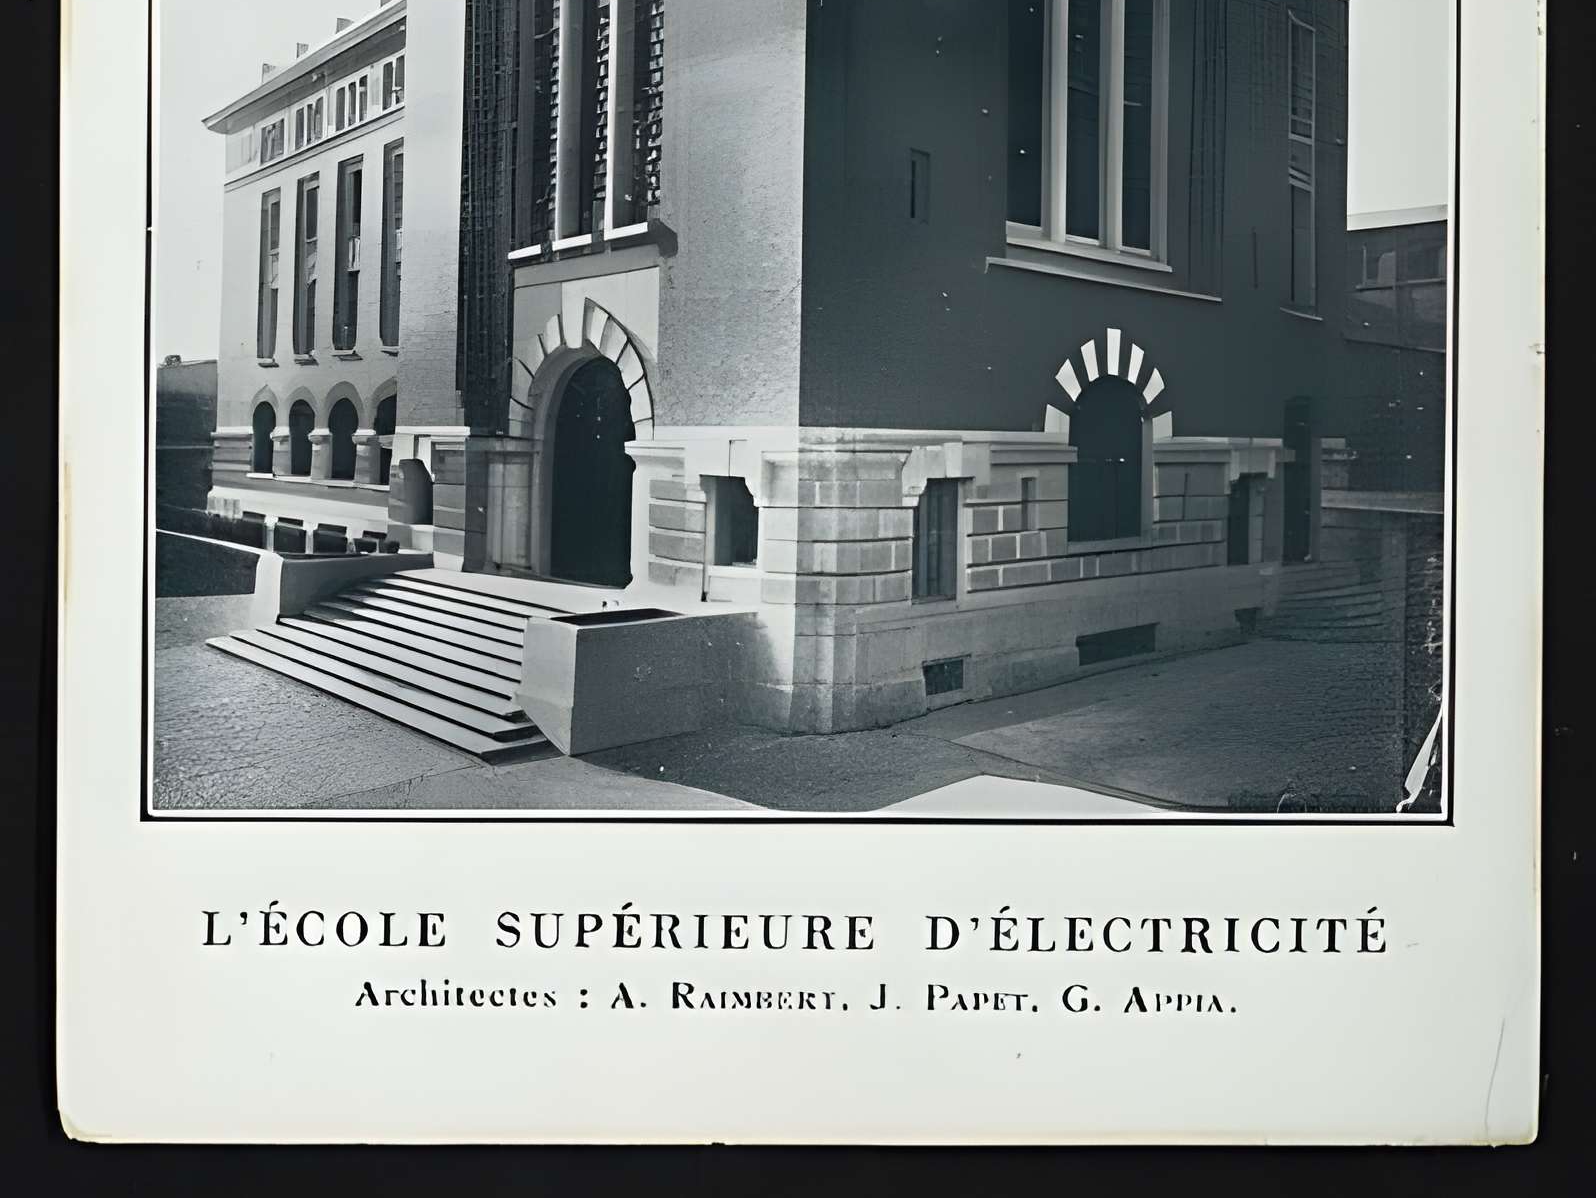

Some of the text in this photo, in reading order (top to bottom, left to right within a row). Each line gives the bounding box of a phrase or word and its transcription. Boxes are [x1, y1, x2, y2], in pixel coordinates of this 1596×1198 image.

[202, 899, 1387, 953] L'ÉCOLE SUPÉRIEURE D'ÉLECTRICITÉ
[354, 978, 558, 1007] Architectes
[610, 982, 647, 1009] A.
[869, 983, 901, 1011] J.
[1061, 984, 1101, 1012] G.
